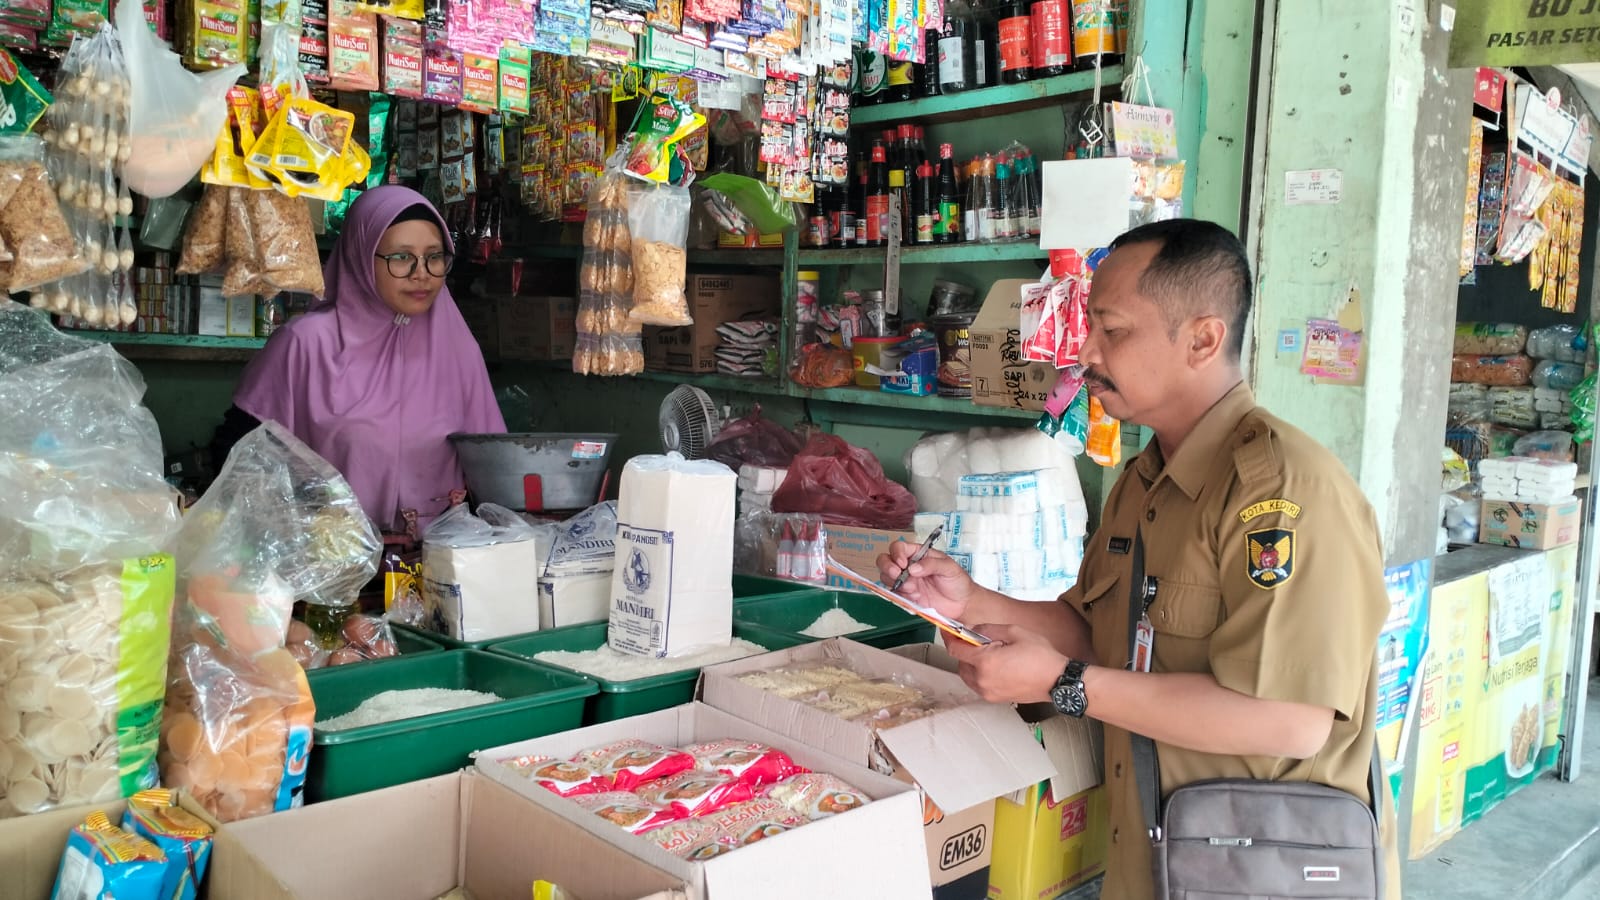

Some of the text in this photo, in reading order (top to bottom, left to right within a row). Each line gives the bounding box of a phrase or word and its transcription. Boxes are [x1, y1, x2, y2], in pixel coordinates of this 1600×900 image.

[1527, 0, 1600, 18] BU J
[202, 18, 235, 34] NutriSari
[334, 34, 368, 51] NutriSari
[1487, 26, 1600, 48] PASAR SET
[299, 38, 327, 53] utriSari
[388, 53, 419, 70] NutriSari
[428, 58, 458, 74] NutriSari
[464, 66, 493, 81] NutriSari
[503, 74, 526, 89] NutriSari
[956, 329, 968, 339] NIS
[1004, 371, 1026, 382] SAPI
[979, 379, 985, 391] 7
[1242, 500, 1299, 519] KOTA KEDIRI
[1061, 805, 1087, 833] 24
[943, 830, 982, 867] EM36
